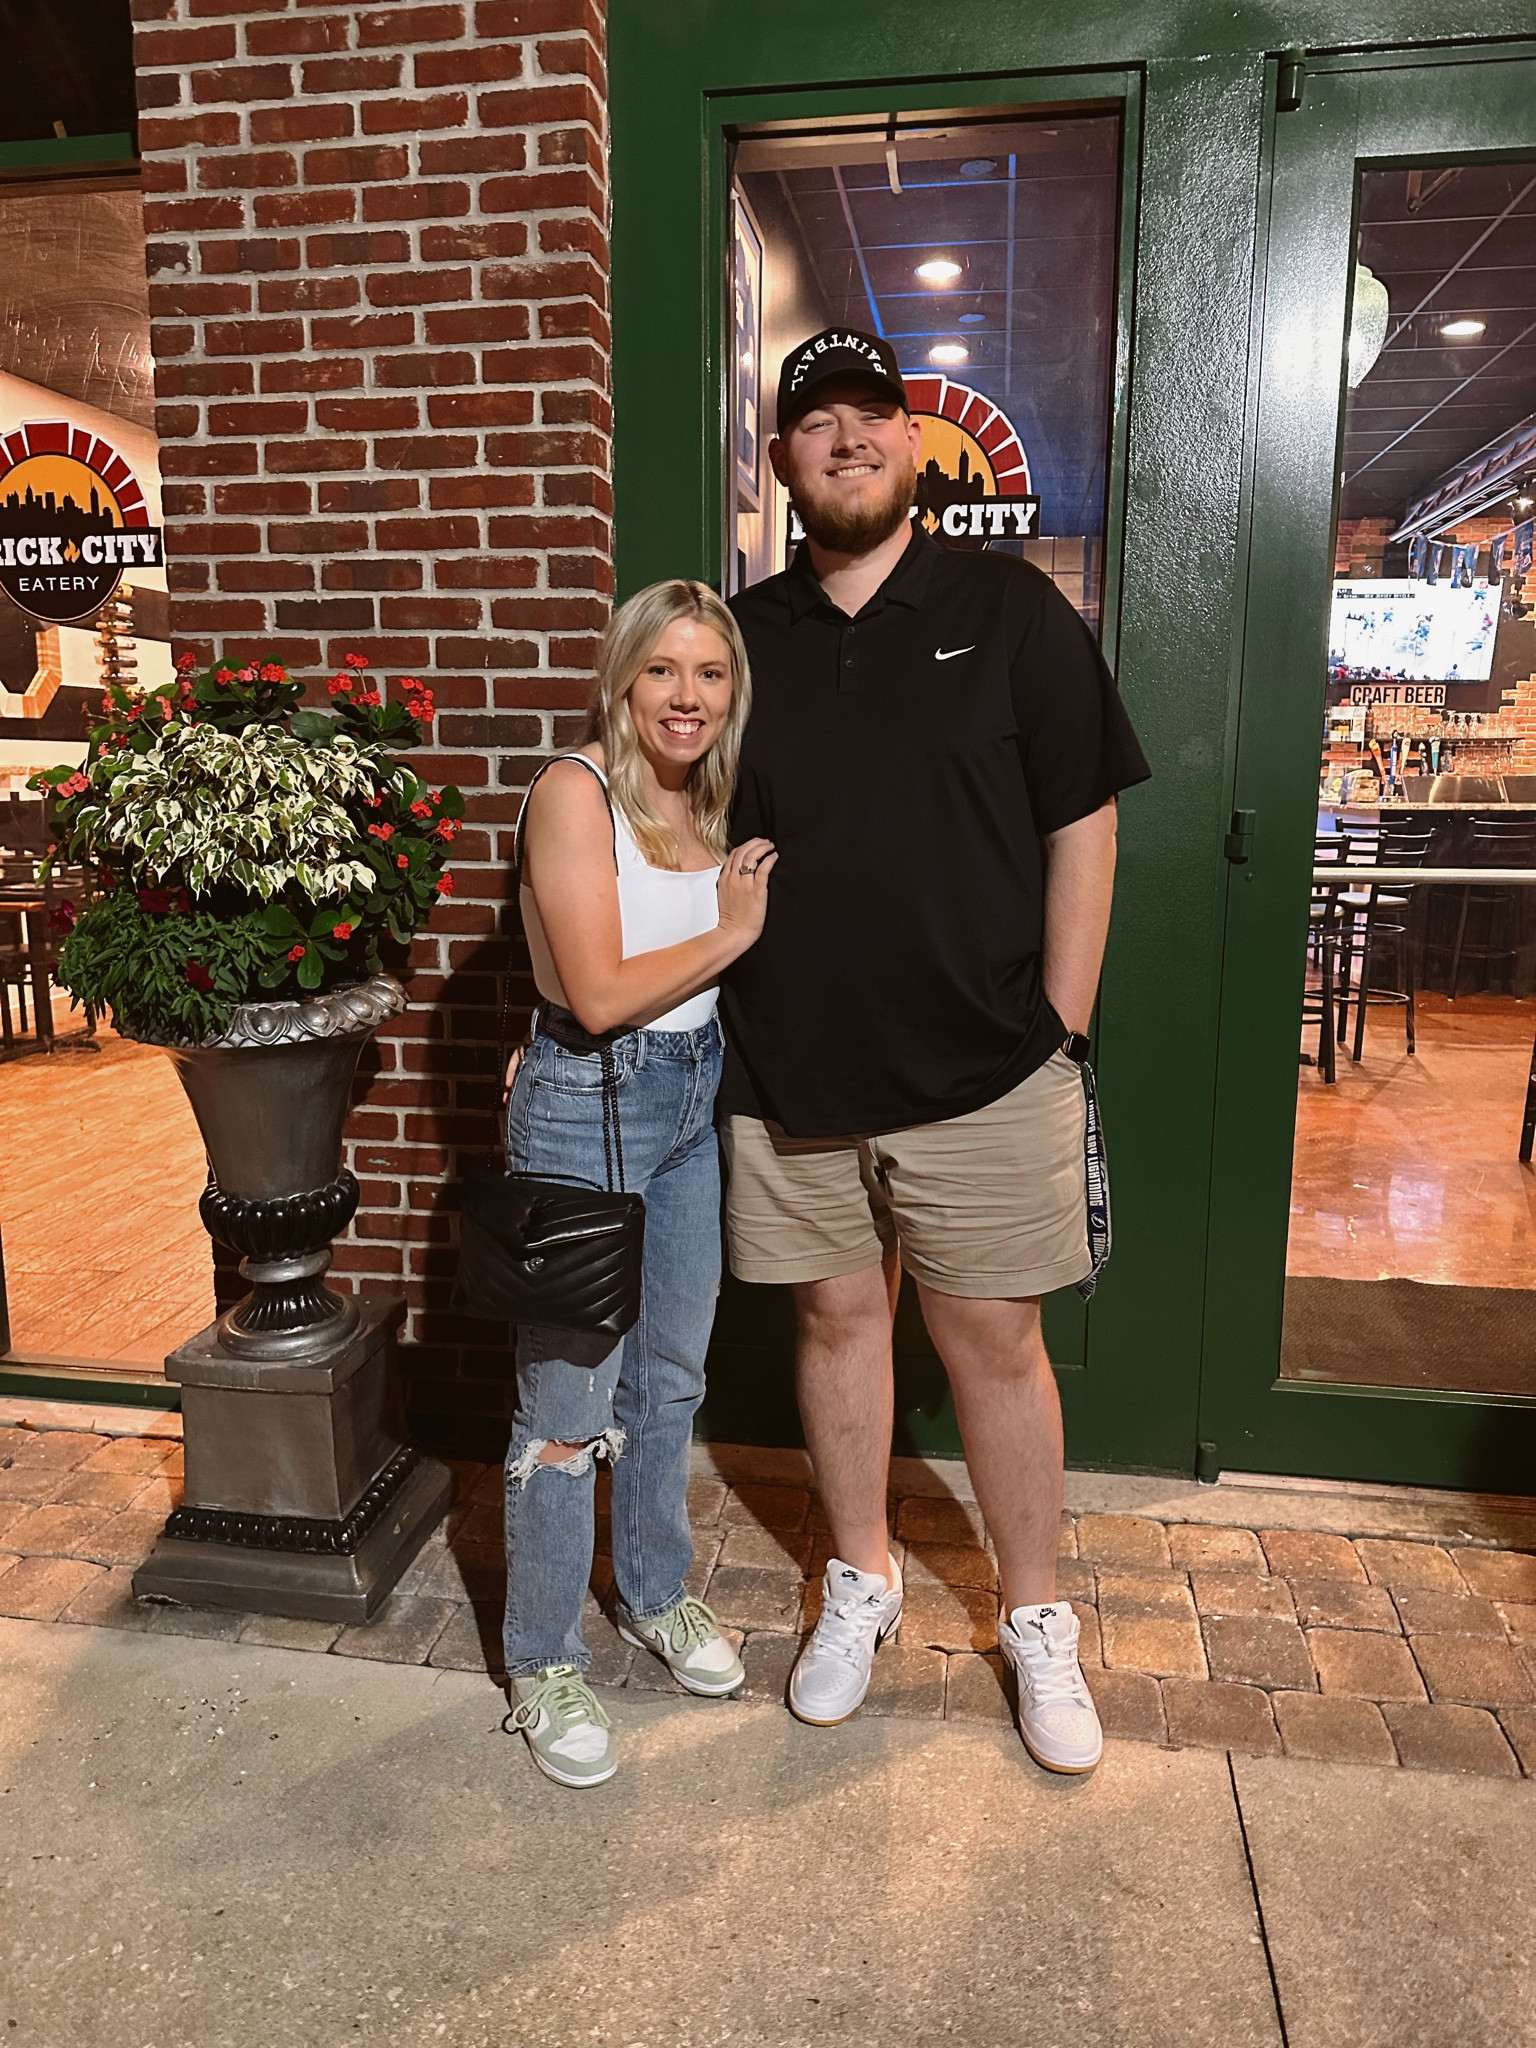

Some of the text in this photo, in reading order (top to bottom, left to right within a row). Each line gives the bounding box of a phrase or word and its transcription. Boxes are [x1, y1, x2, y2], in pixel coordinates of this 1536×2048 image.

[791, 333, 887, 392] PAINTBALL
[942, 503, 1037, 536] CITY
[0, 534, 159, 567] ICK CITY
[19, 576, 100, 592] EATERY
[1352, 686, 1444, 704] CRAFT BEER
[1087, 1134, 1098, 1154] BAY
[1087, 1156, 1104, 1208] LIGHTNING
